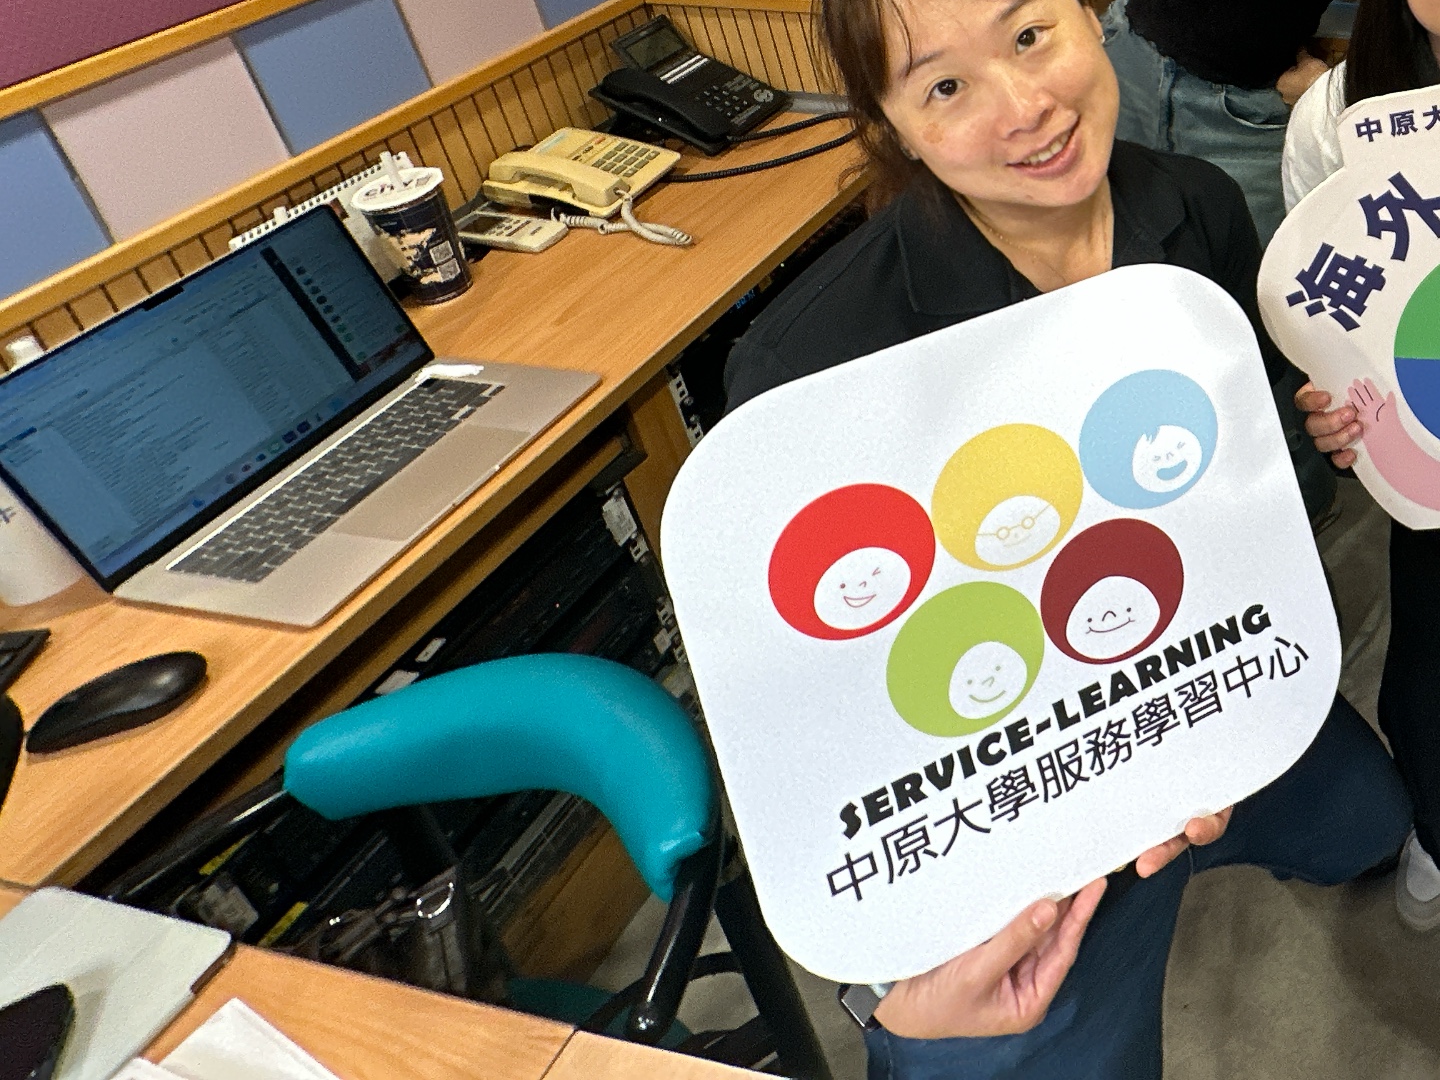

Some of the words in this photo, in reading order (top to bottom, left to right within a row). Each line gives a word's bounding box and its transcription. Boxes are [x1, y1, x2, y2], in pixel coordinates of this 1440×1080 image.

[825, 635, 1310, 904] 中原大學服務學習中心
[838, 603, 1272, 840] SERVICE-LEARNING
